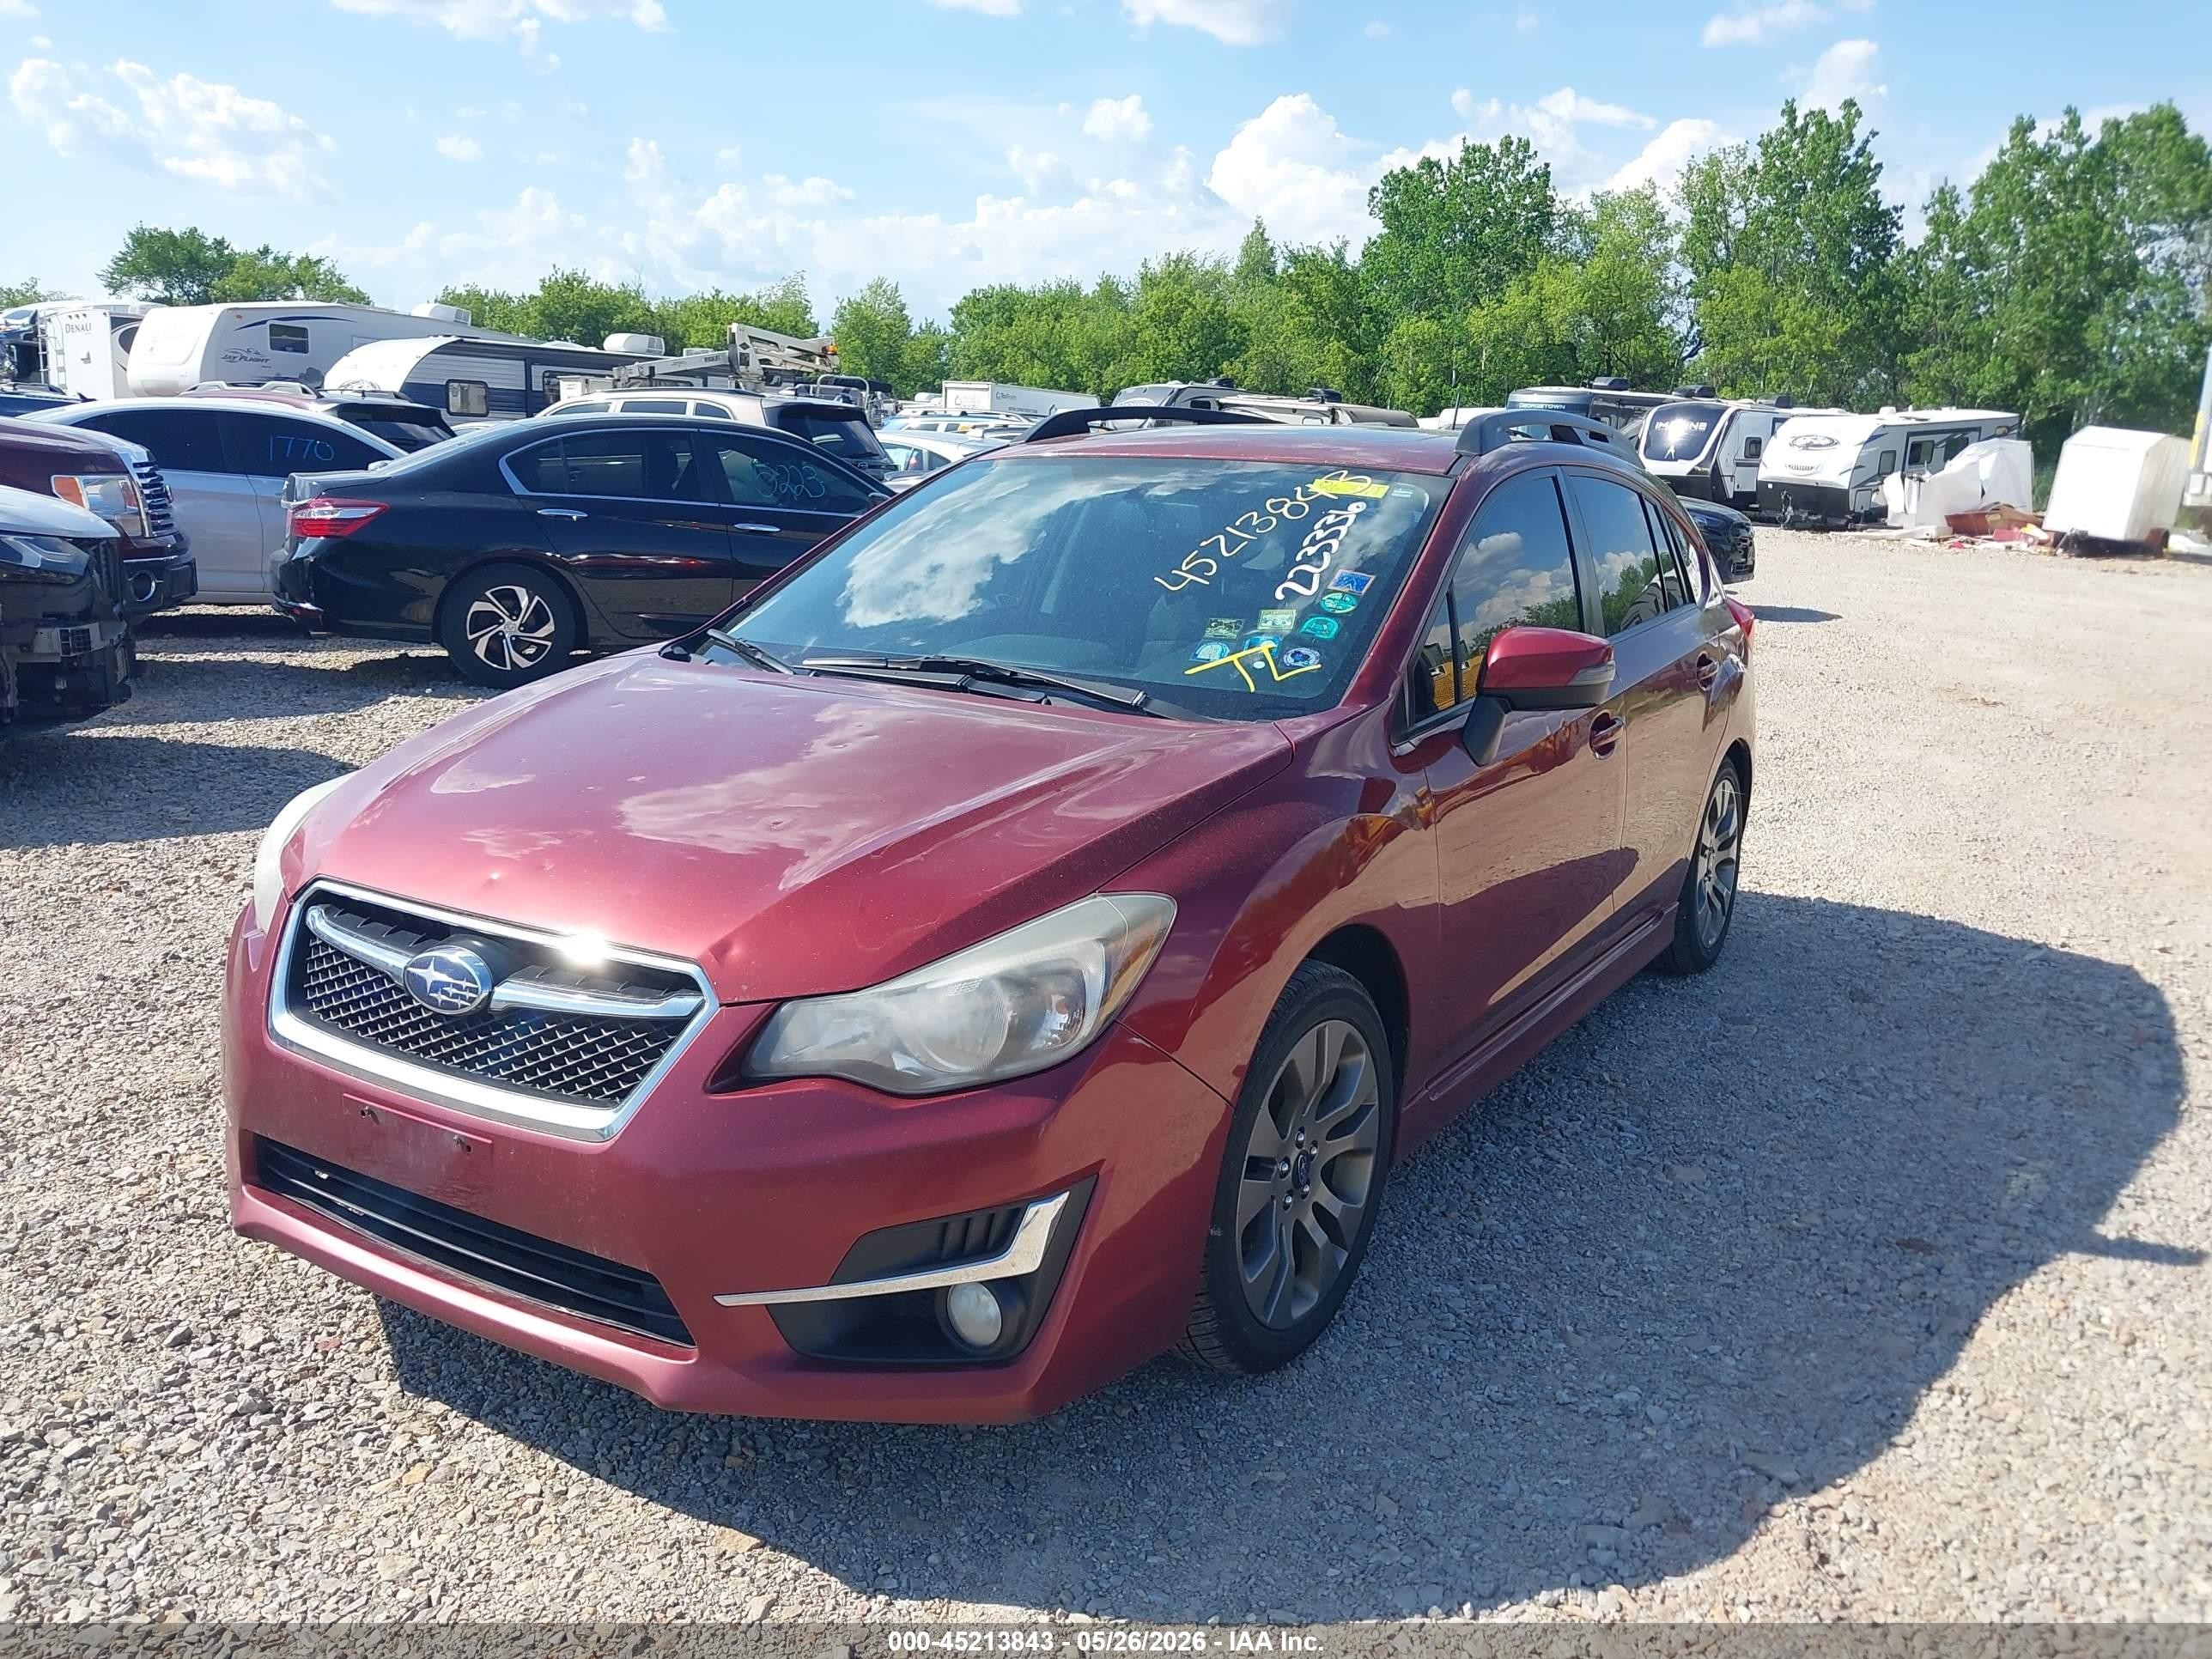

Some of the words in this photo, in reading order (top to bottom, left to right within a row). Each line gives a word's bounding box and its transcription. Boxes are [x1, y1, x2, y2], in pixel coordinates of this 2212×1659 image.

[64, 323, 92, 334] DENALI
[269, 434, 335, 462] 1770
[1153, 470, 1372, 591] 45213843
